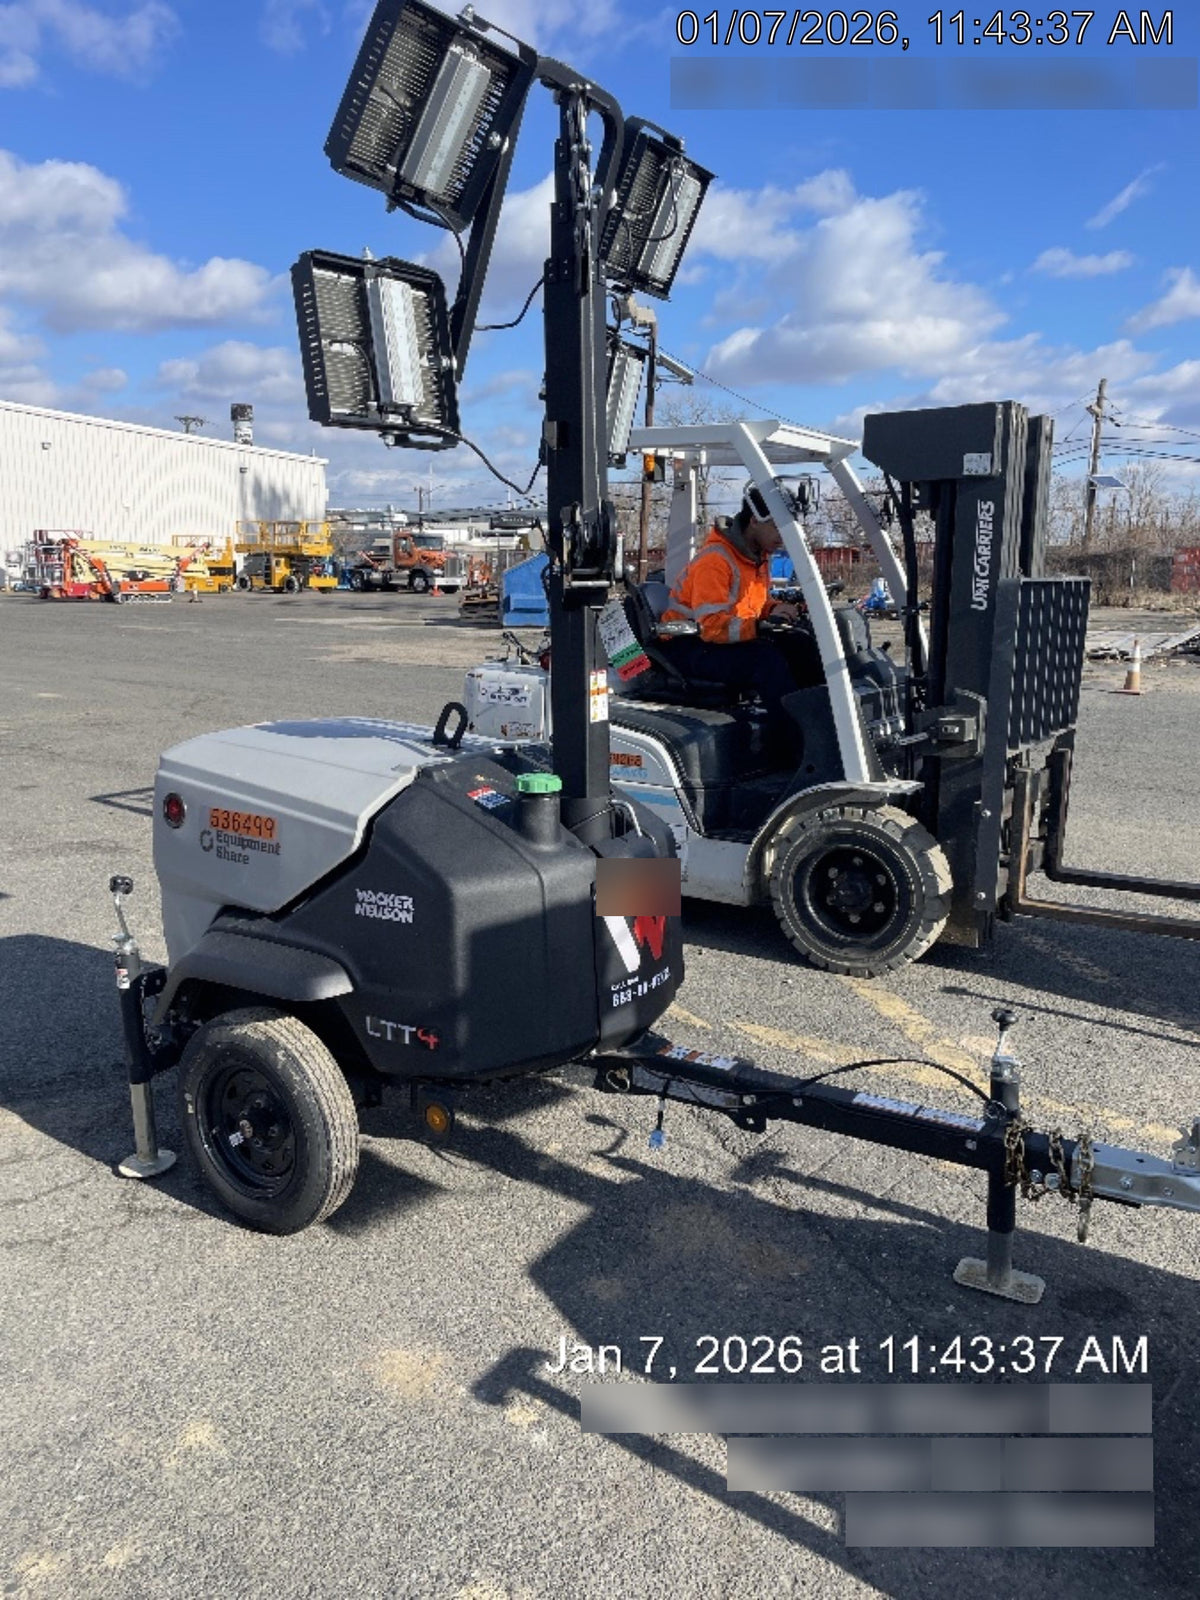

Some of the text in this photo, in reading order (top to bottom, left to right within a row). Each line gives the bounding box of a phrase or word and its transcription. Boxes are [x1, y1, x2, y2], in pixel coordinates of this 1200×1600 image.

[210, 808, 275, 838] 536499
[215, 829, 281, 856] Equipment
[215, 845, 250, 865] Share
[355, 888, 415, 911] WACKER
[354, 902, 414, 924] NEUSON
[365, 1015, 440, 1050] LTT4
